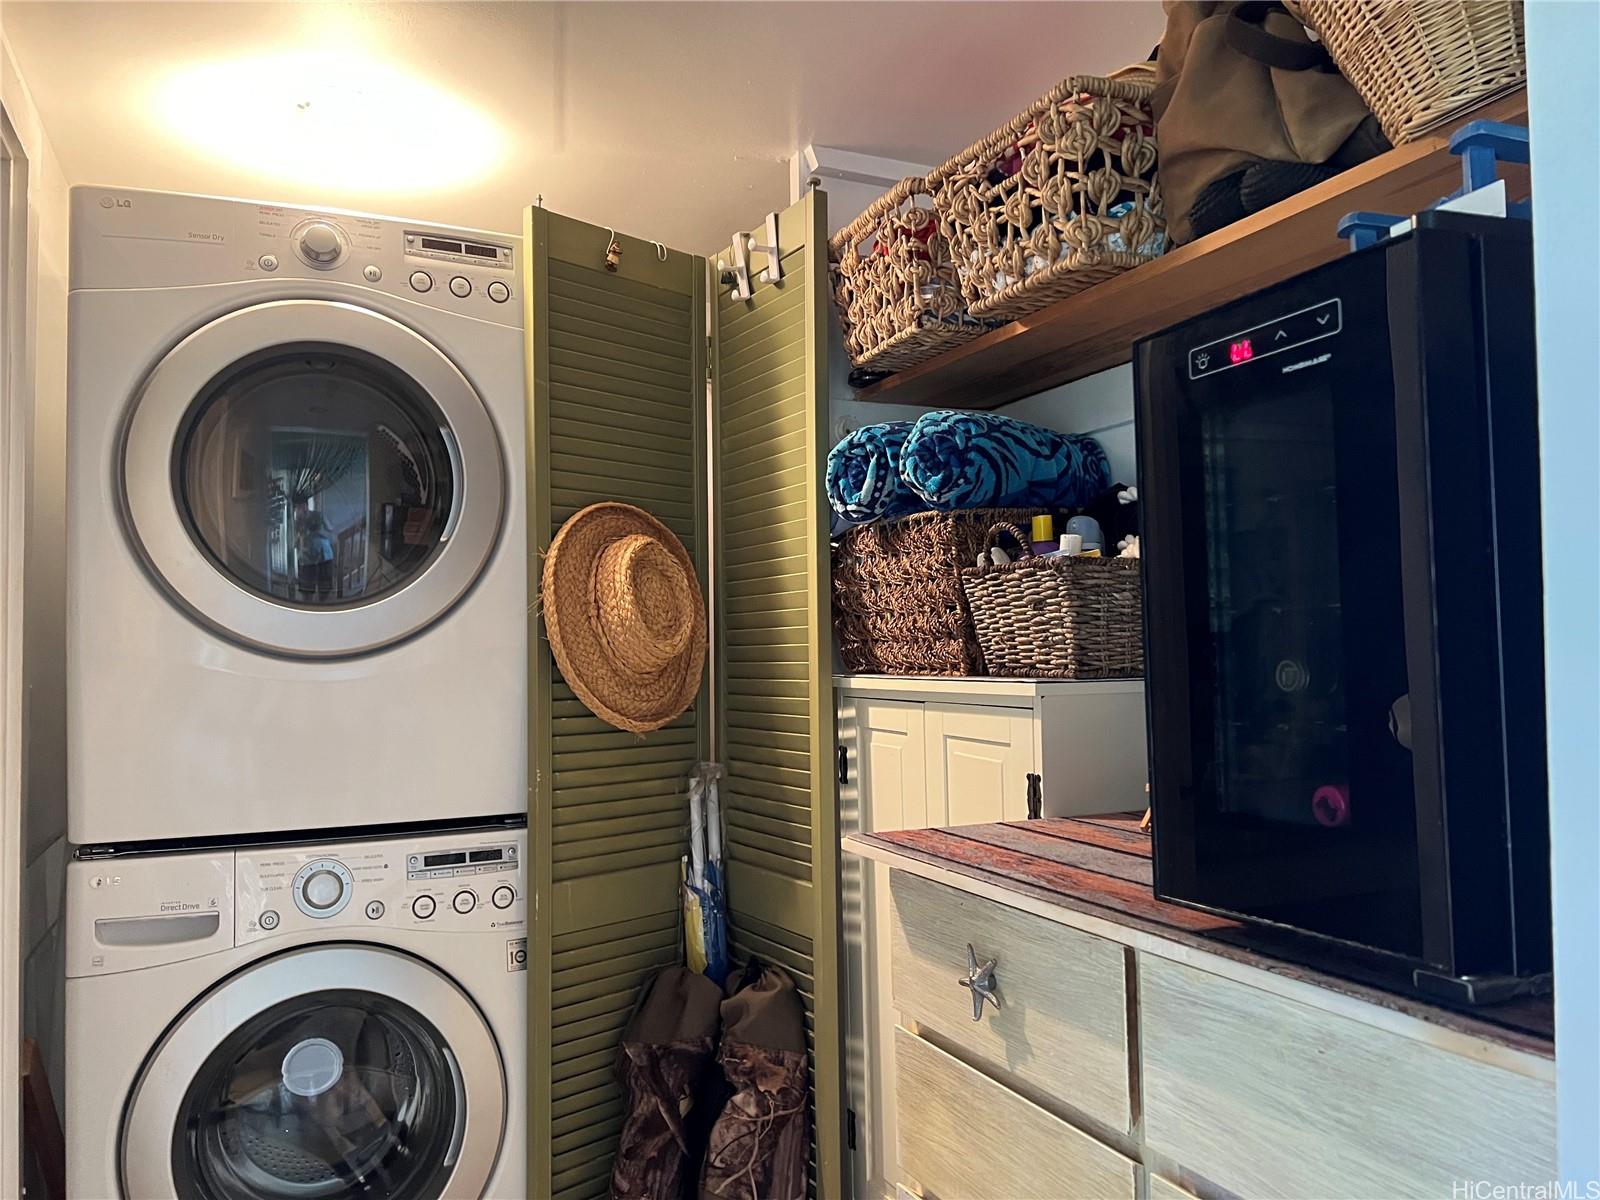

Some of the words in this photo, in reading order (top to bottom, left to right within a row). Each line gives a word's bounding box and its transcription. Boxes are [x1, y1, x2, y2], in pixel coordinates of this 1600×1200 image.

[116, 199, 132, 208] LG
[188, 231, 211, 240] Sensor
[212, 233, 225, 242] Dry
[160, 903, 181, 912] Direct
[182, 902, 200, 911] Drive
